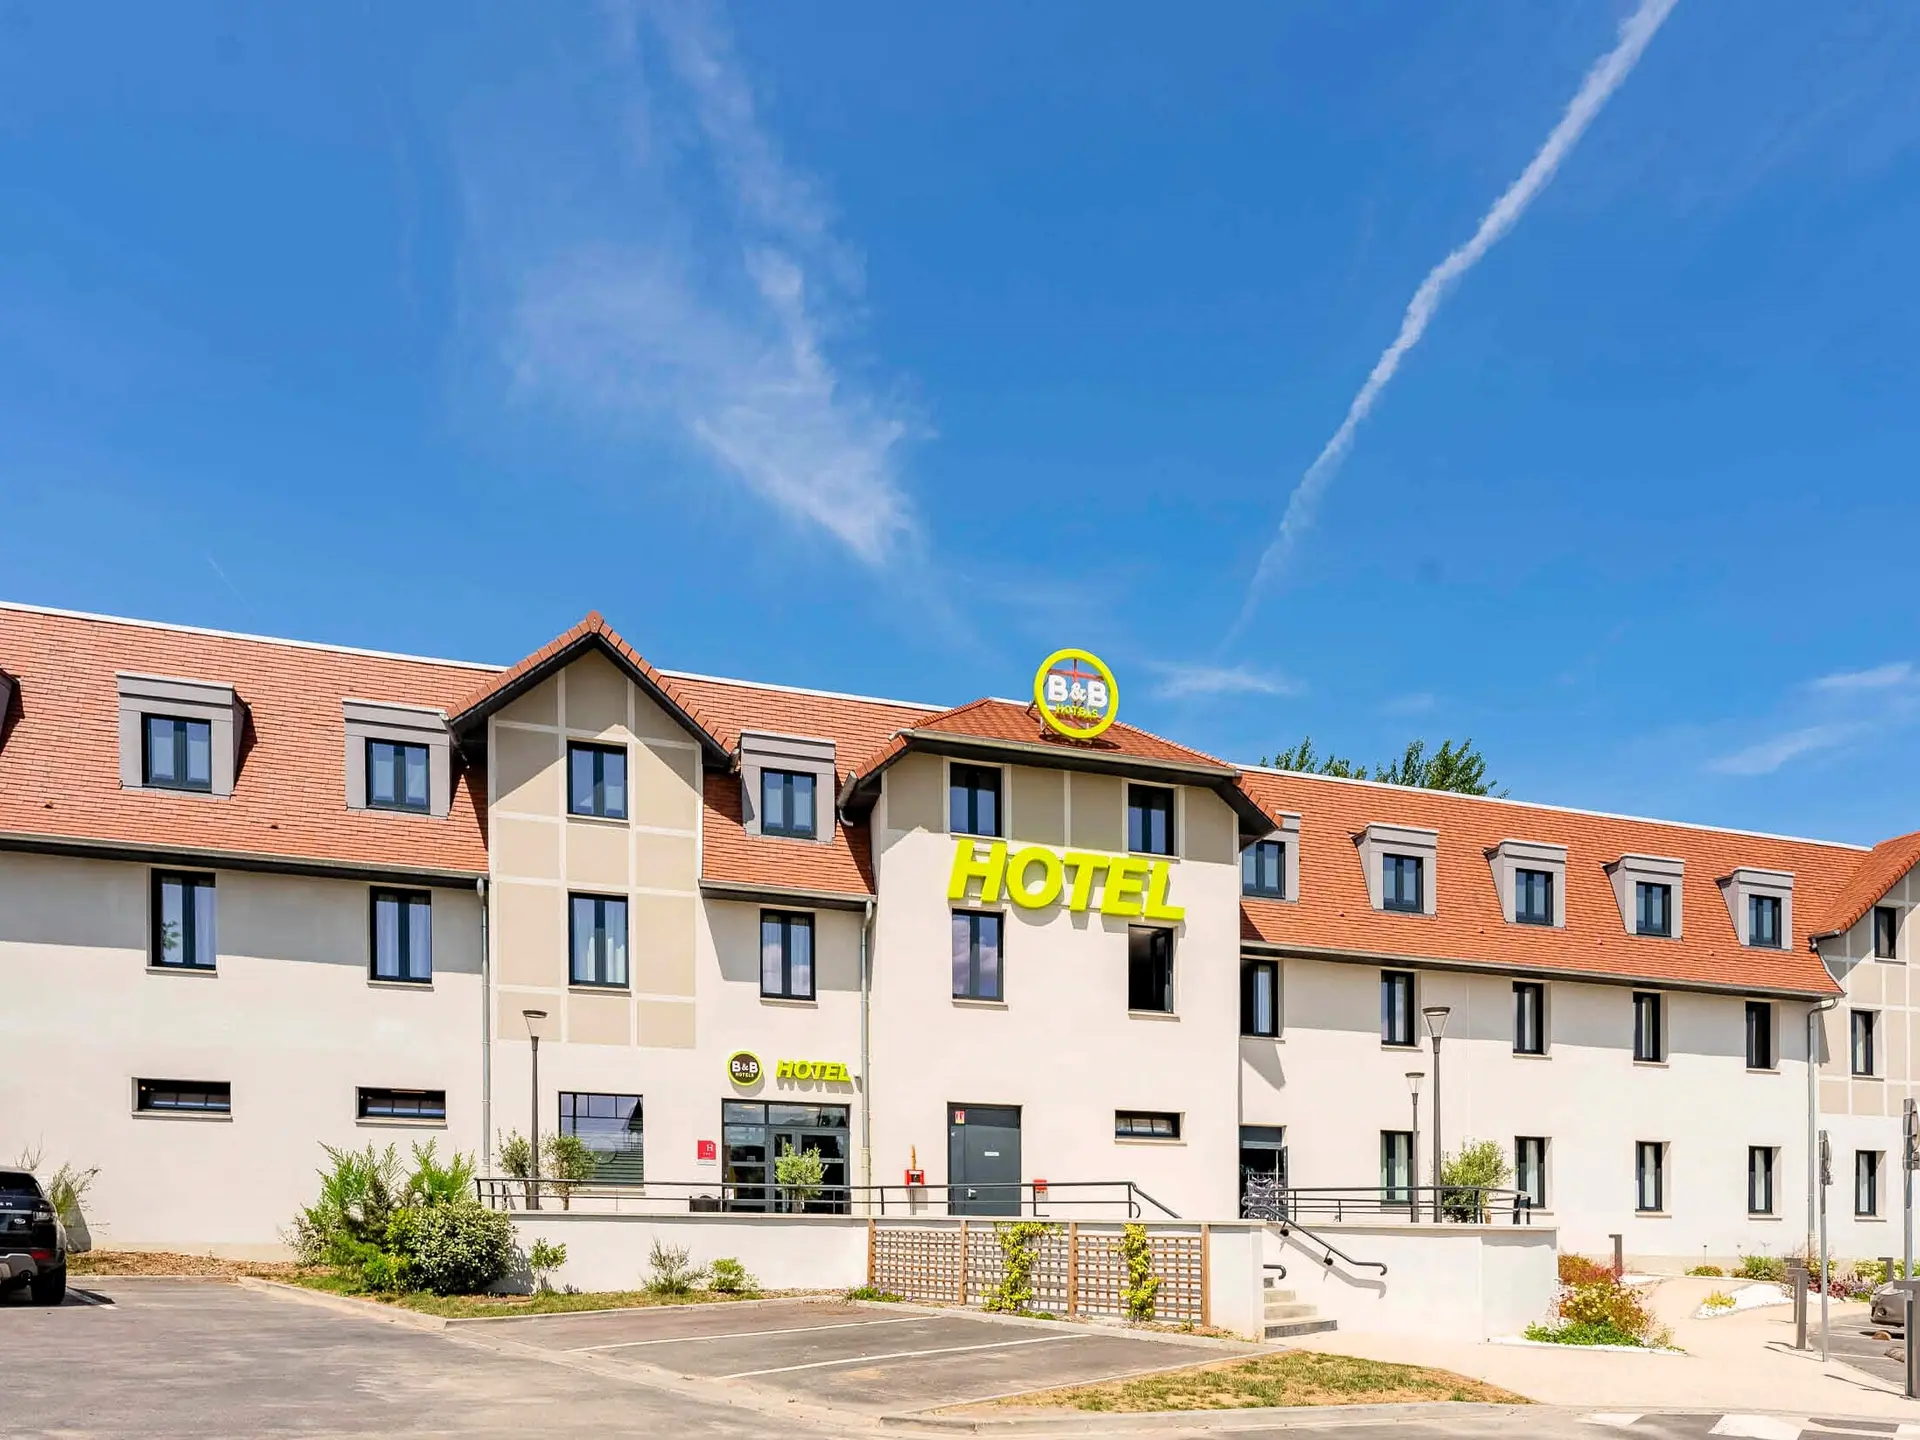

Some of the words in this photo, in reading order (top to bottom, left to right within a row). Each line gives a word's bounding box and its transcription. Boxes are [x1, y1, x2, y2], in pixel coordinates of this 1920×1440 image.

[1048, 675, 1108, 707] B&B
[1056, 704, 1099, 717] HOTELS
[947, 838, 1186, 920] HOTEL
[732, 1061, 758, 1073] B&B
[776, 1060, 851, 1082] HOTEL
